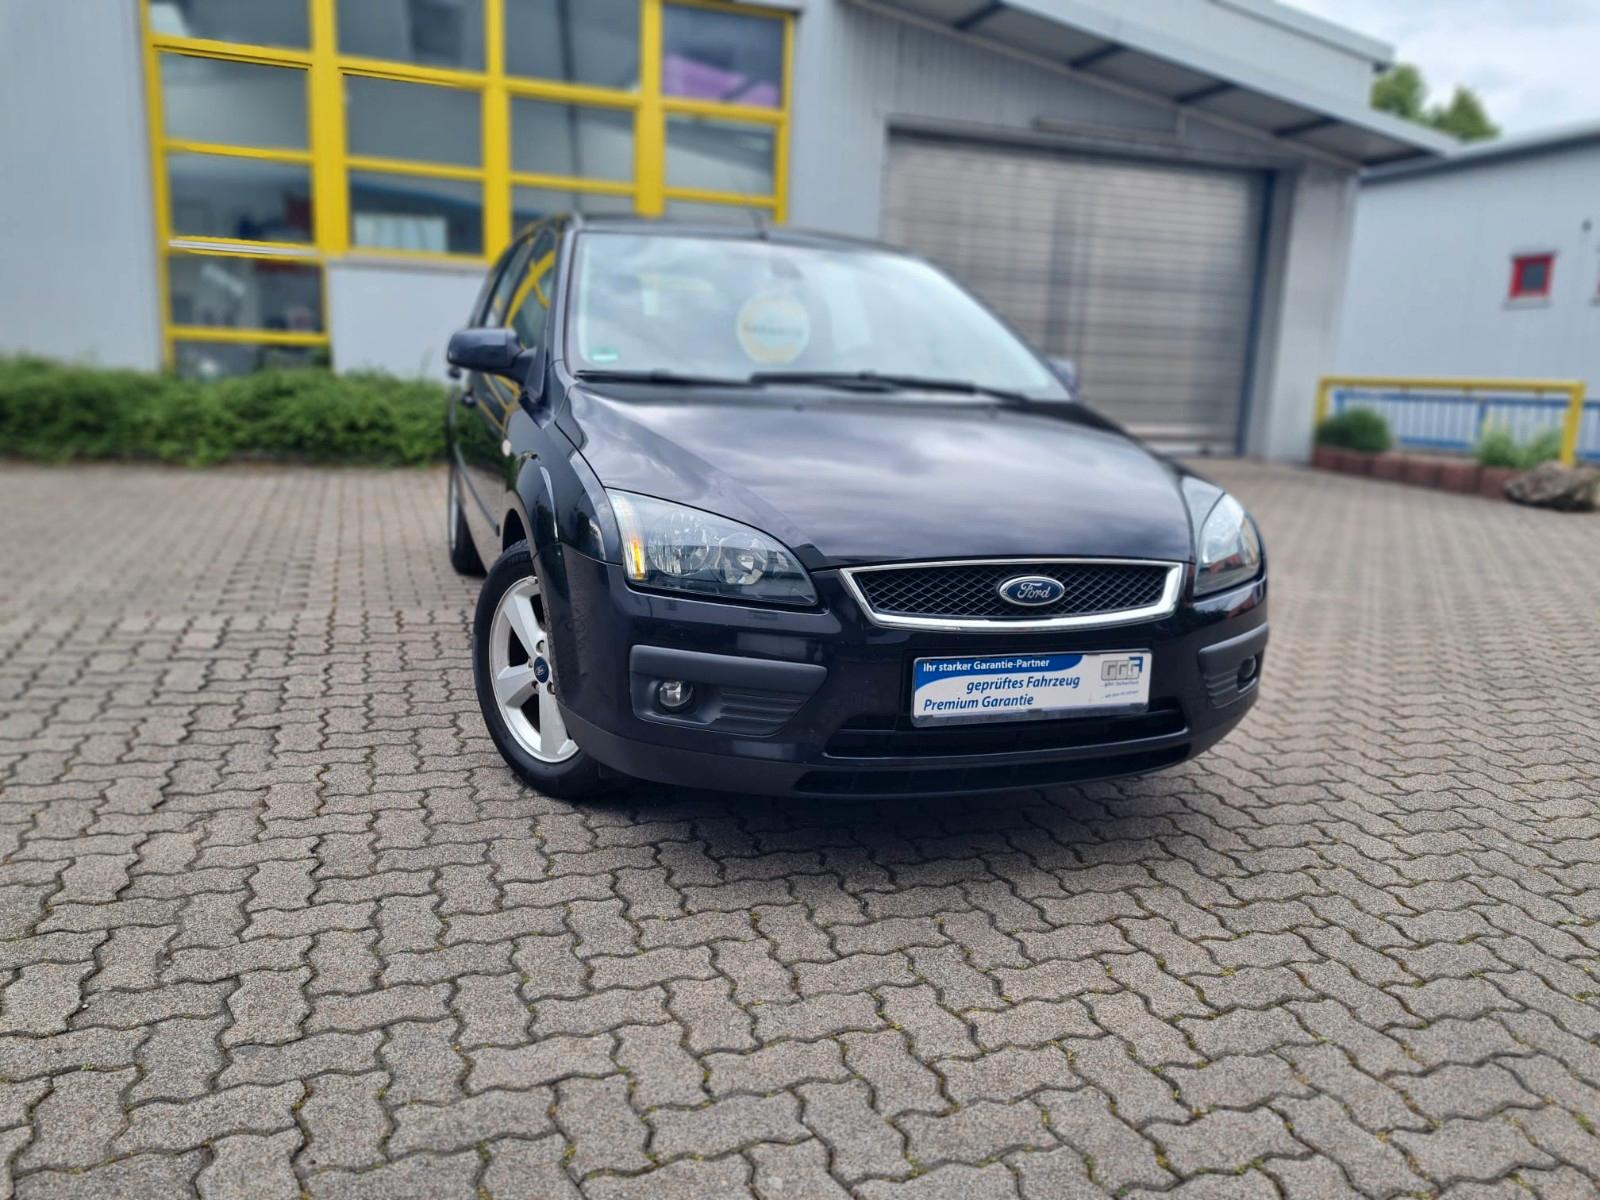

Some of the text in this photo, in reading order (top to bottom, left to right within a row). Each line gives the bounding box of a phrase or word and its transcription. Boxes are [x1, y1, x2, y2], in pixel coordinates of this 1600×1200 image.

[1017, 582, 1051, 598] Ford
[923, 659, 1050, 672] Ihr starker Garantie-Partner
[966, 675, 1080, 694] geprüftes Fahrzeug
[923, 694, 1034, 711] Premium Garantie
